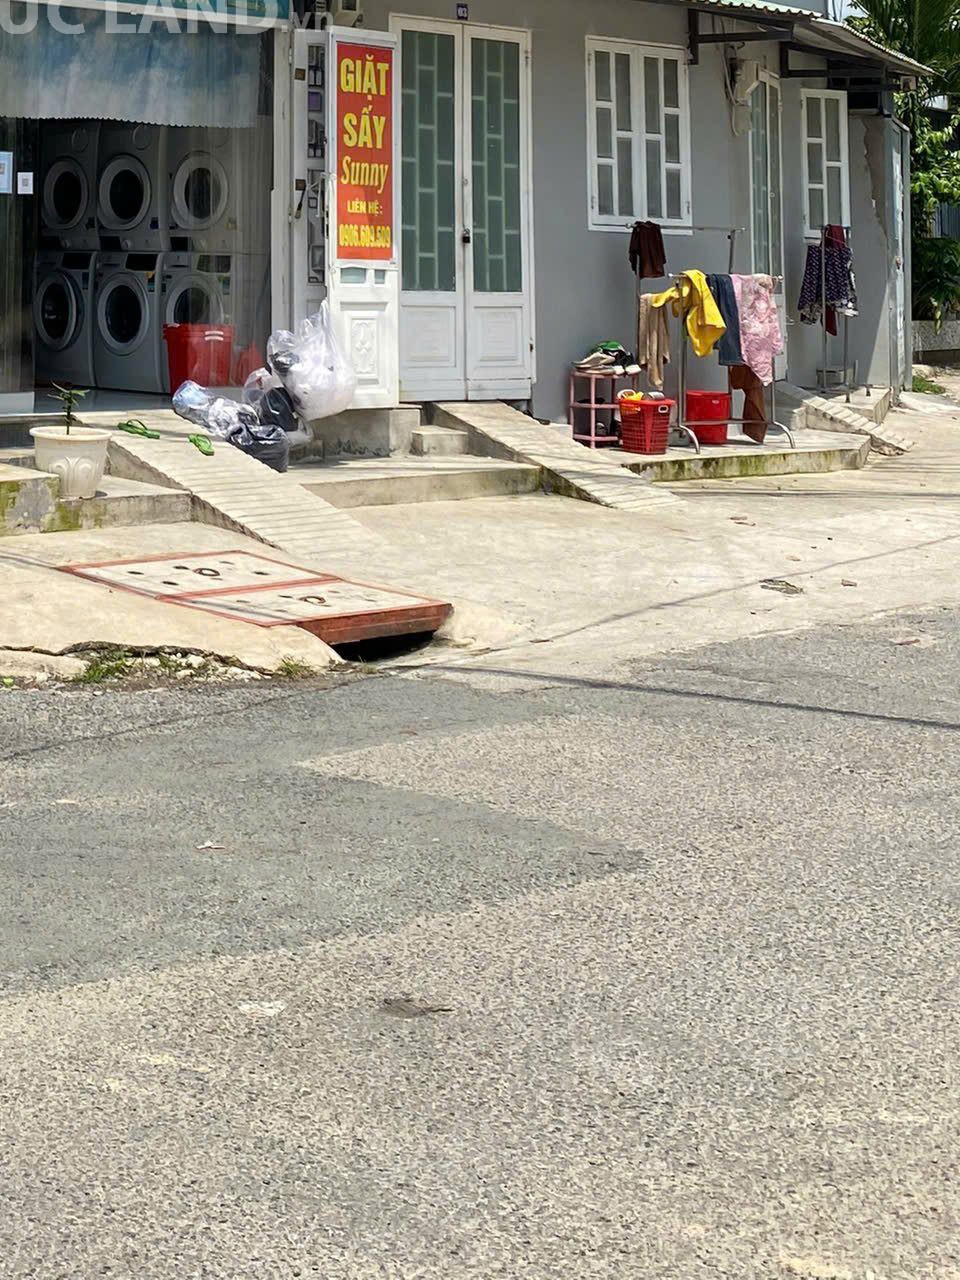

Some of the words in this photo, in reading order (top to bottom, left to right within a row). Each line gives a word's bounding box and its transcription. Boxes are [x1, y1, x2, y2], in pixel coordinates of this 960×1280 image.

[340, 54, 390, 101] GIẶT
[343, 105, 387, 149] SẤY
[340, 156, 389, 194] Sunny
[347, 198, 367, 214] LIÊN
